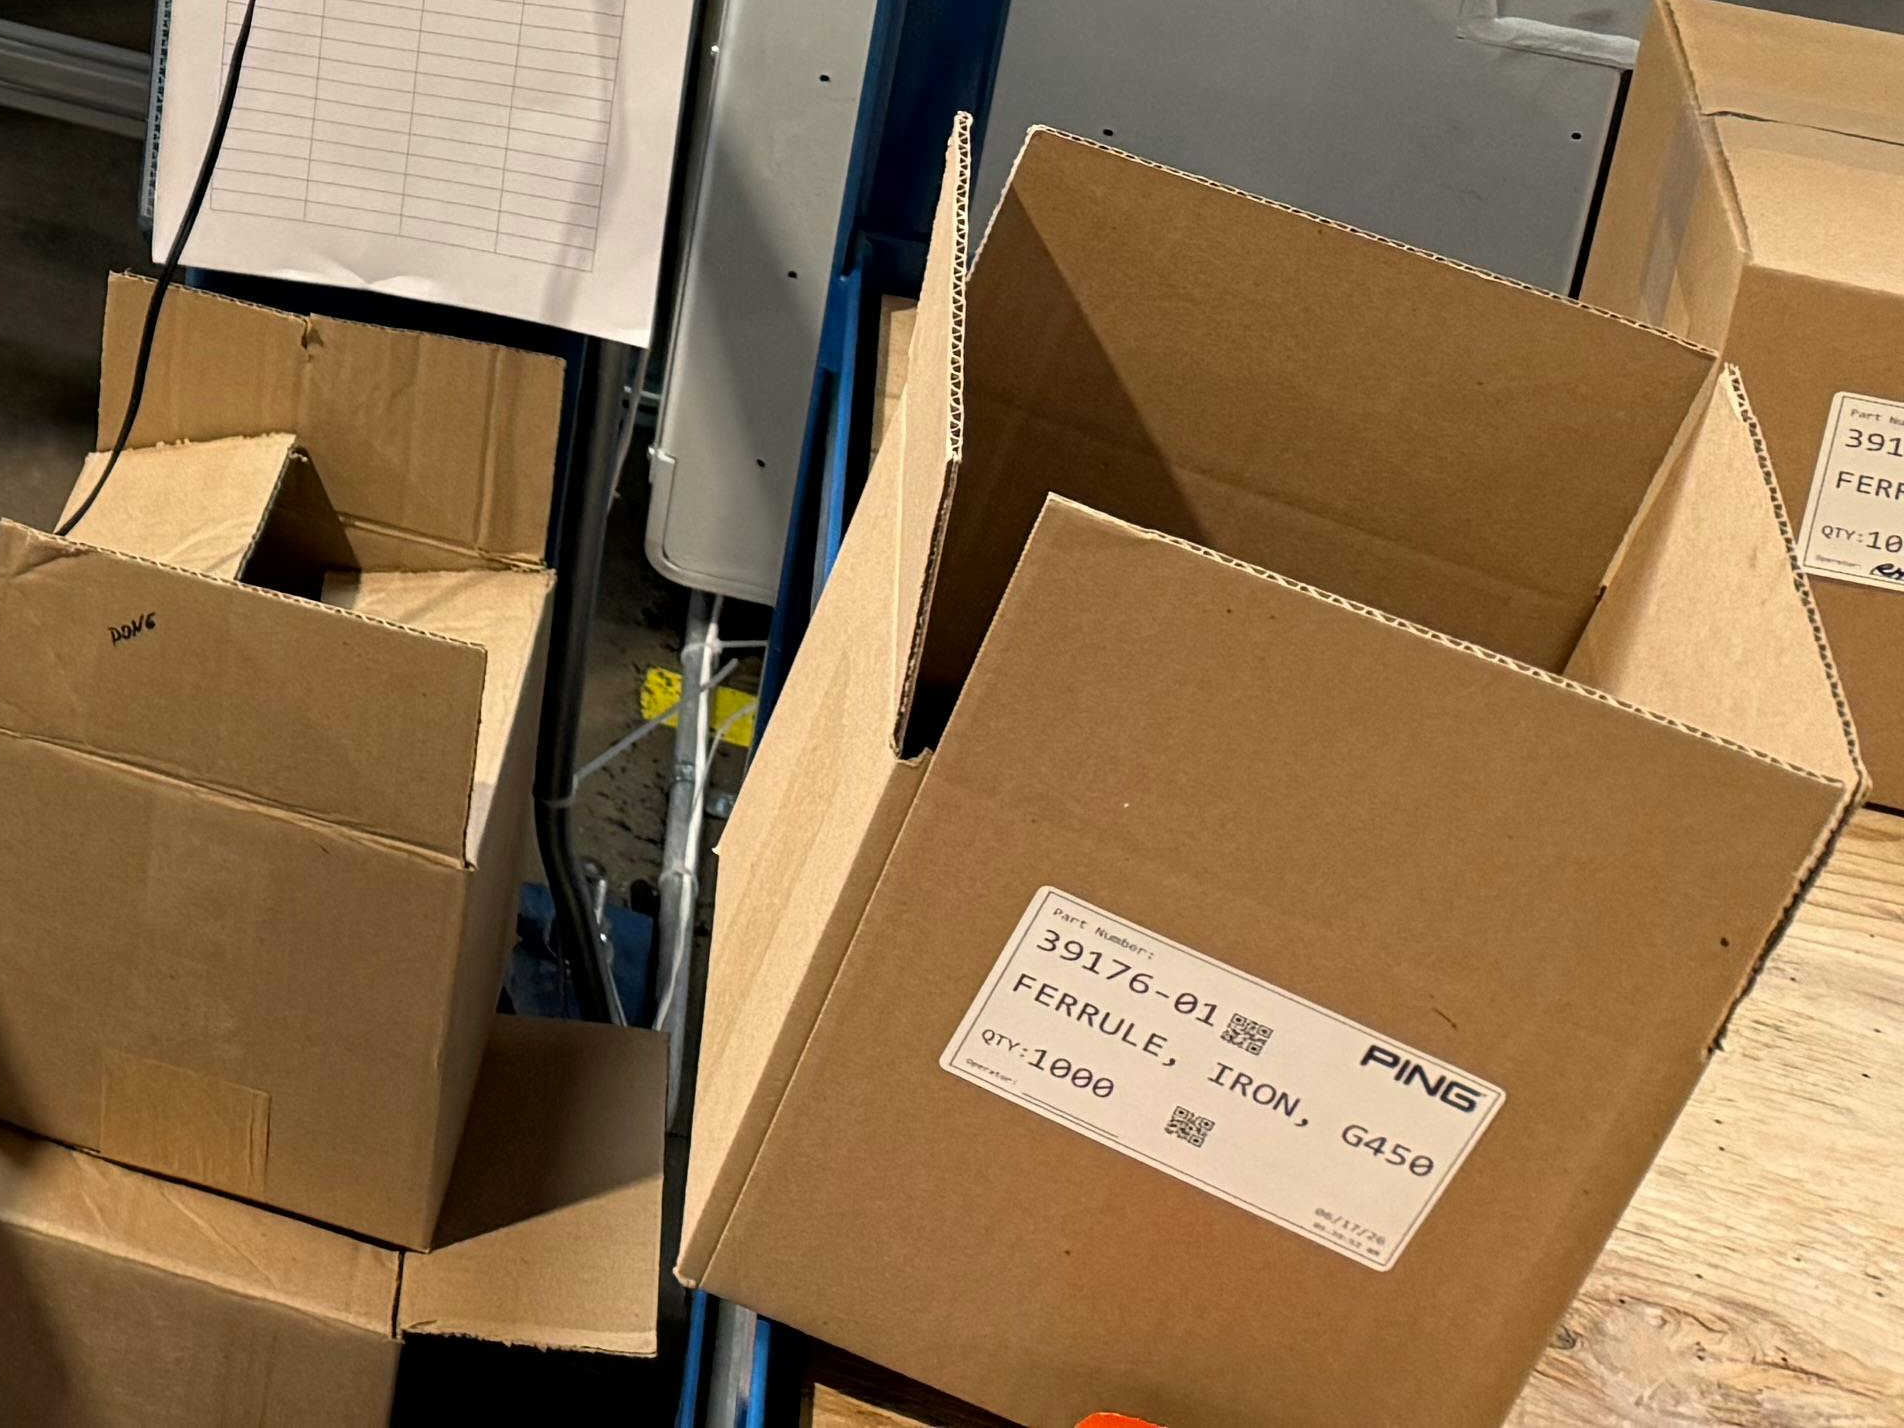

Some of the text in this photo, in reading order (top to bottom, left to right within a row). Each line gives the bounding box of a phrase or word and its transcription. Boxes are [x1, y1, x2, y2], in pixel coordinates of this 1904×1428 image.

[1052, 907, 1155, 960] Part Number:
[1036, 928, 1218, 1028] 39176-01
[1012, 972, 1434, 1177] FERRULE, IRON, G450
[1359, 1044, 1482, 1114] PING
